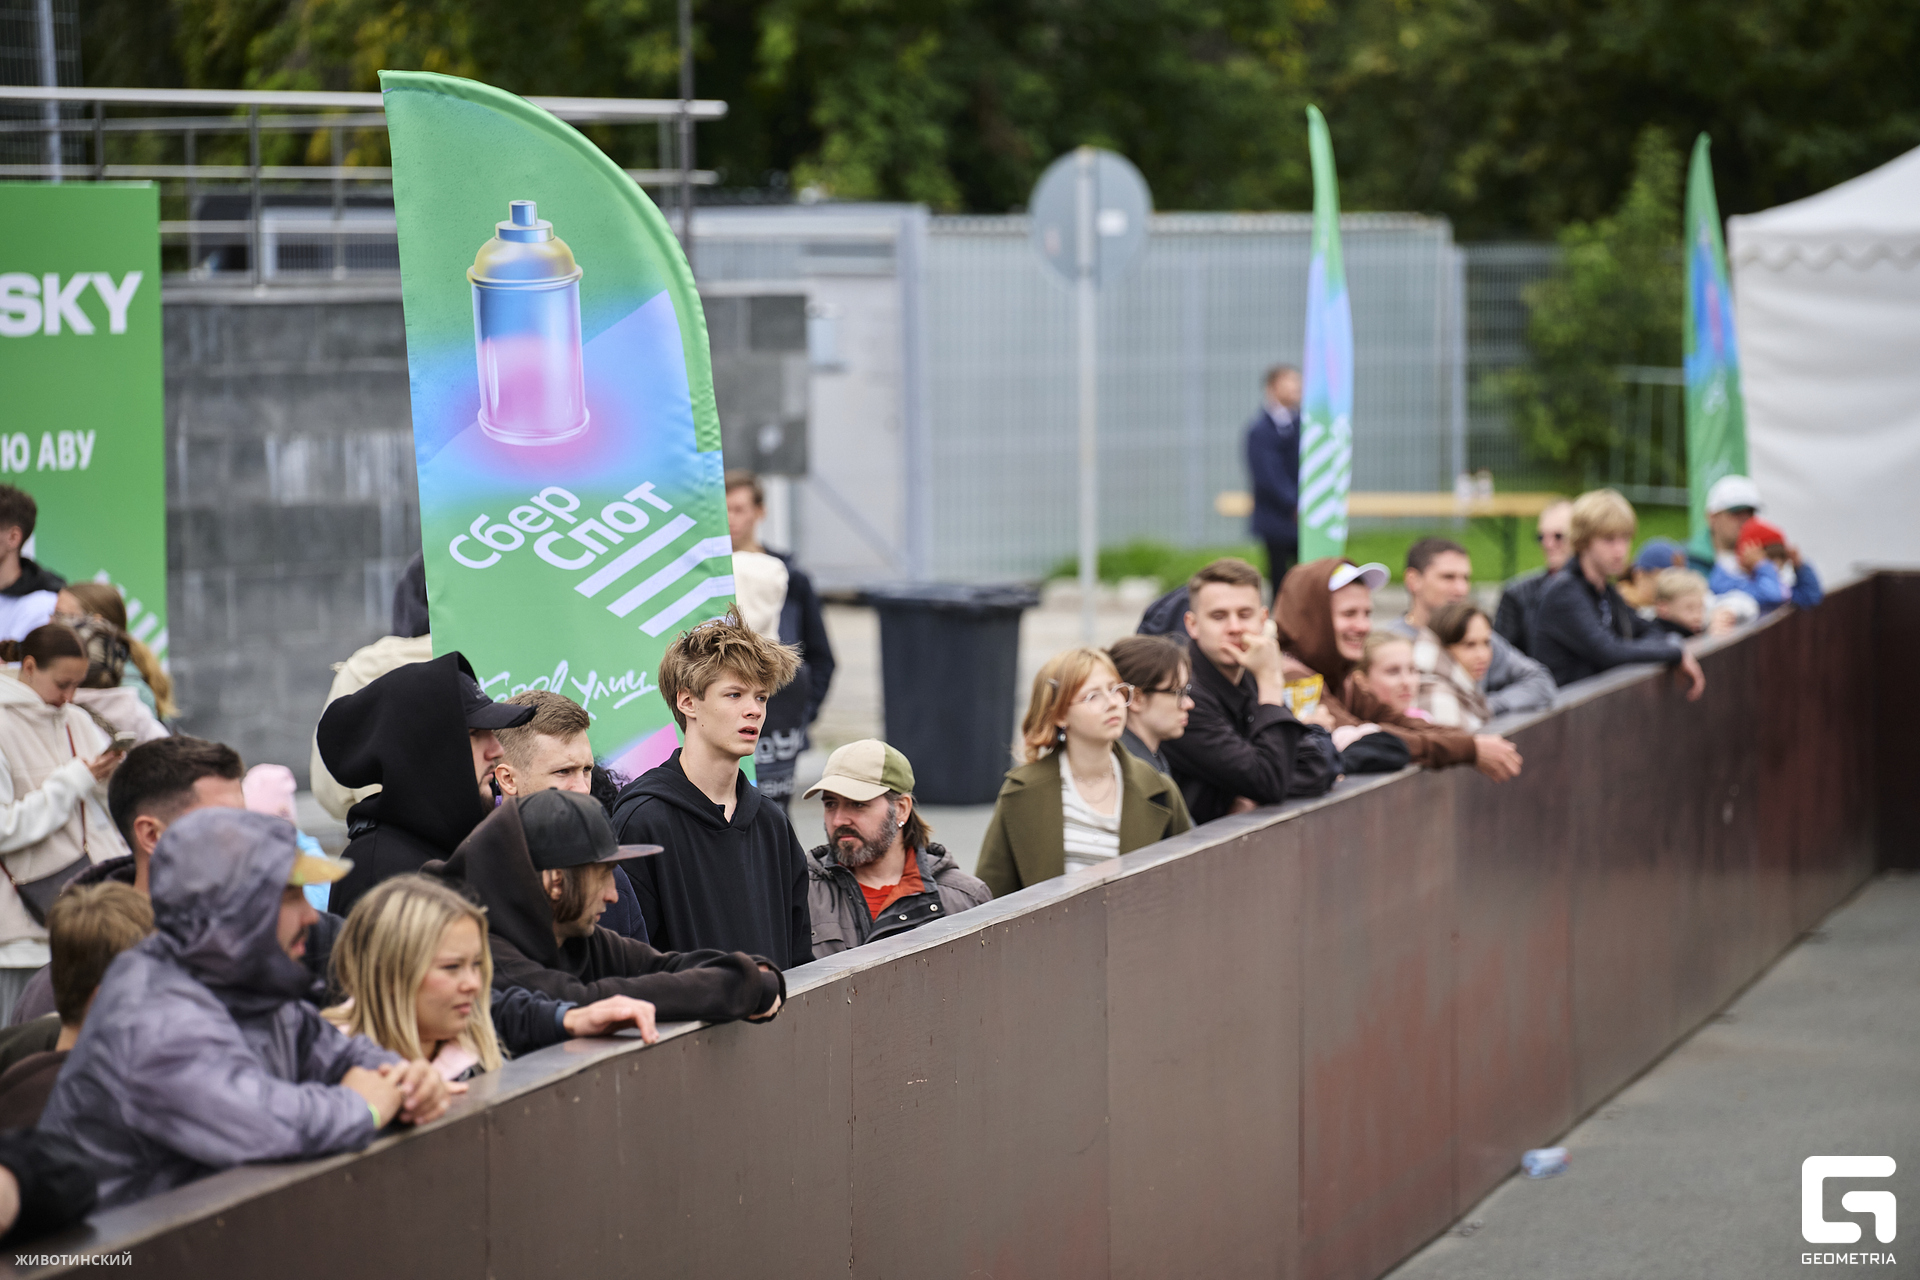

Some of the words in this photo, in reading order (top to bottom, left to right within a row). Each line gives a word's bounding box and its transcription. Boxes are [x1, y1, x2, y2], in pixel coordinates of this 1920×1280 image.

[0, 270, 144, 338] SKY
[36, 429, 96, 472] АВУ
[449, 486, 581, 569] Сбер
[533, 480, 673, 570] Спот
